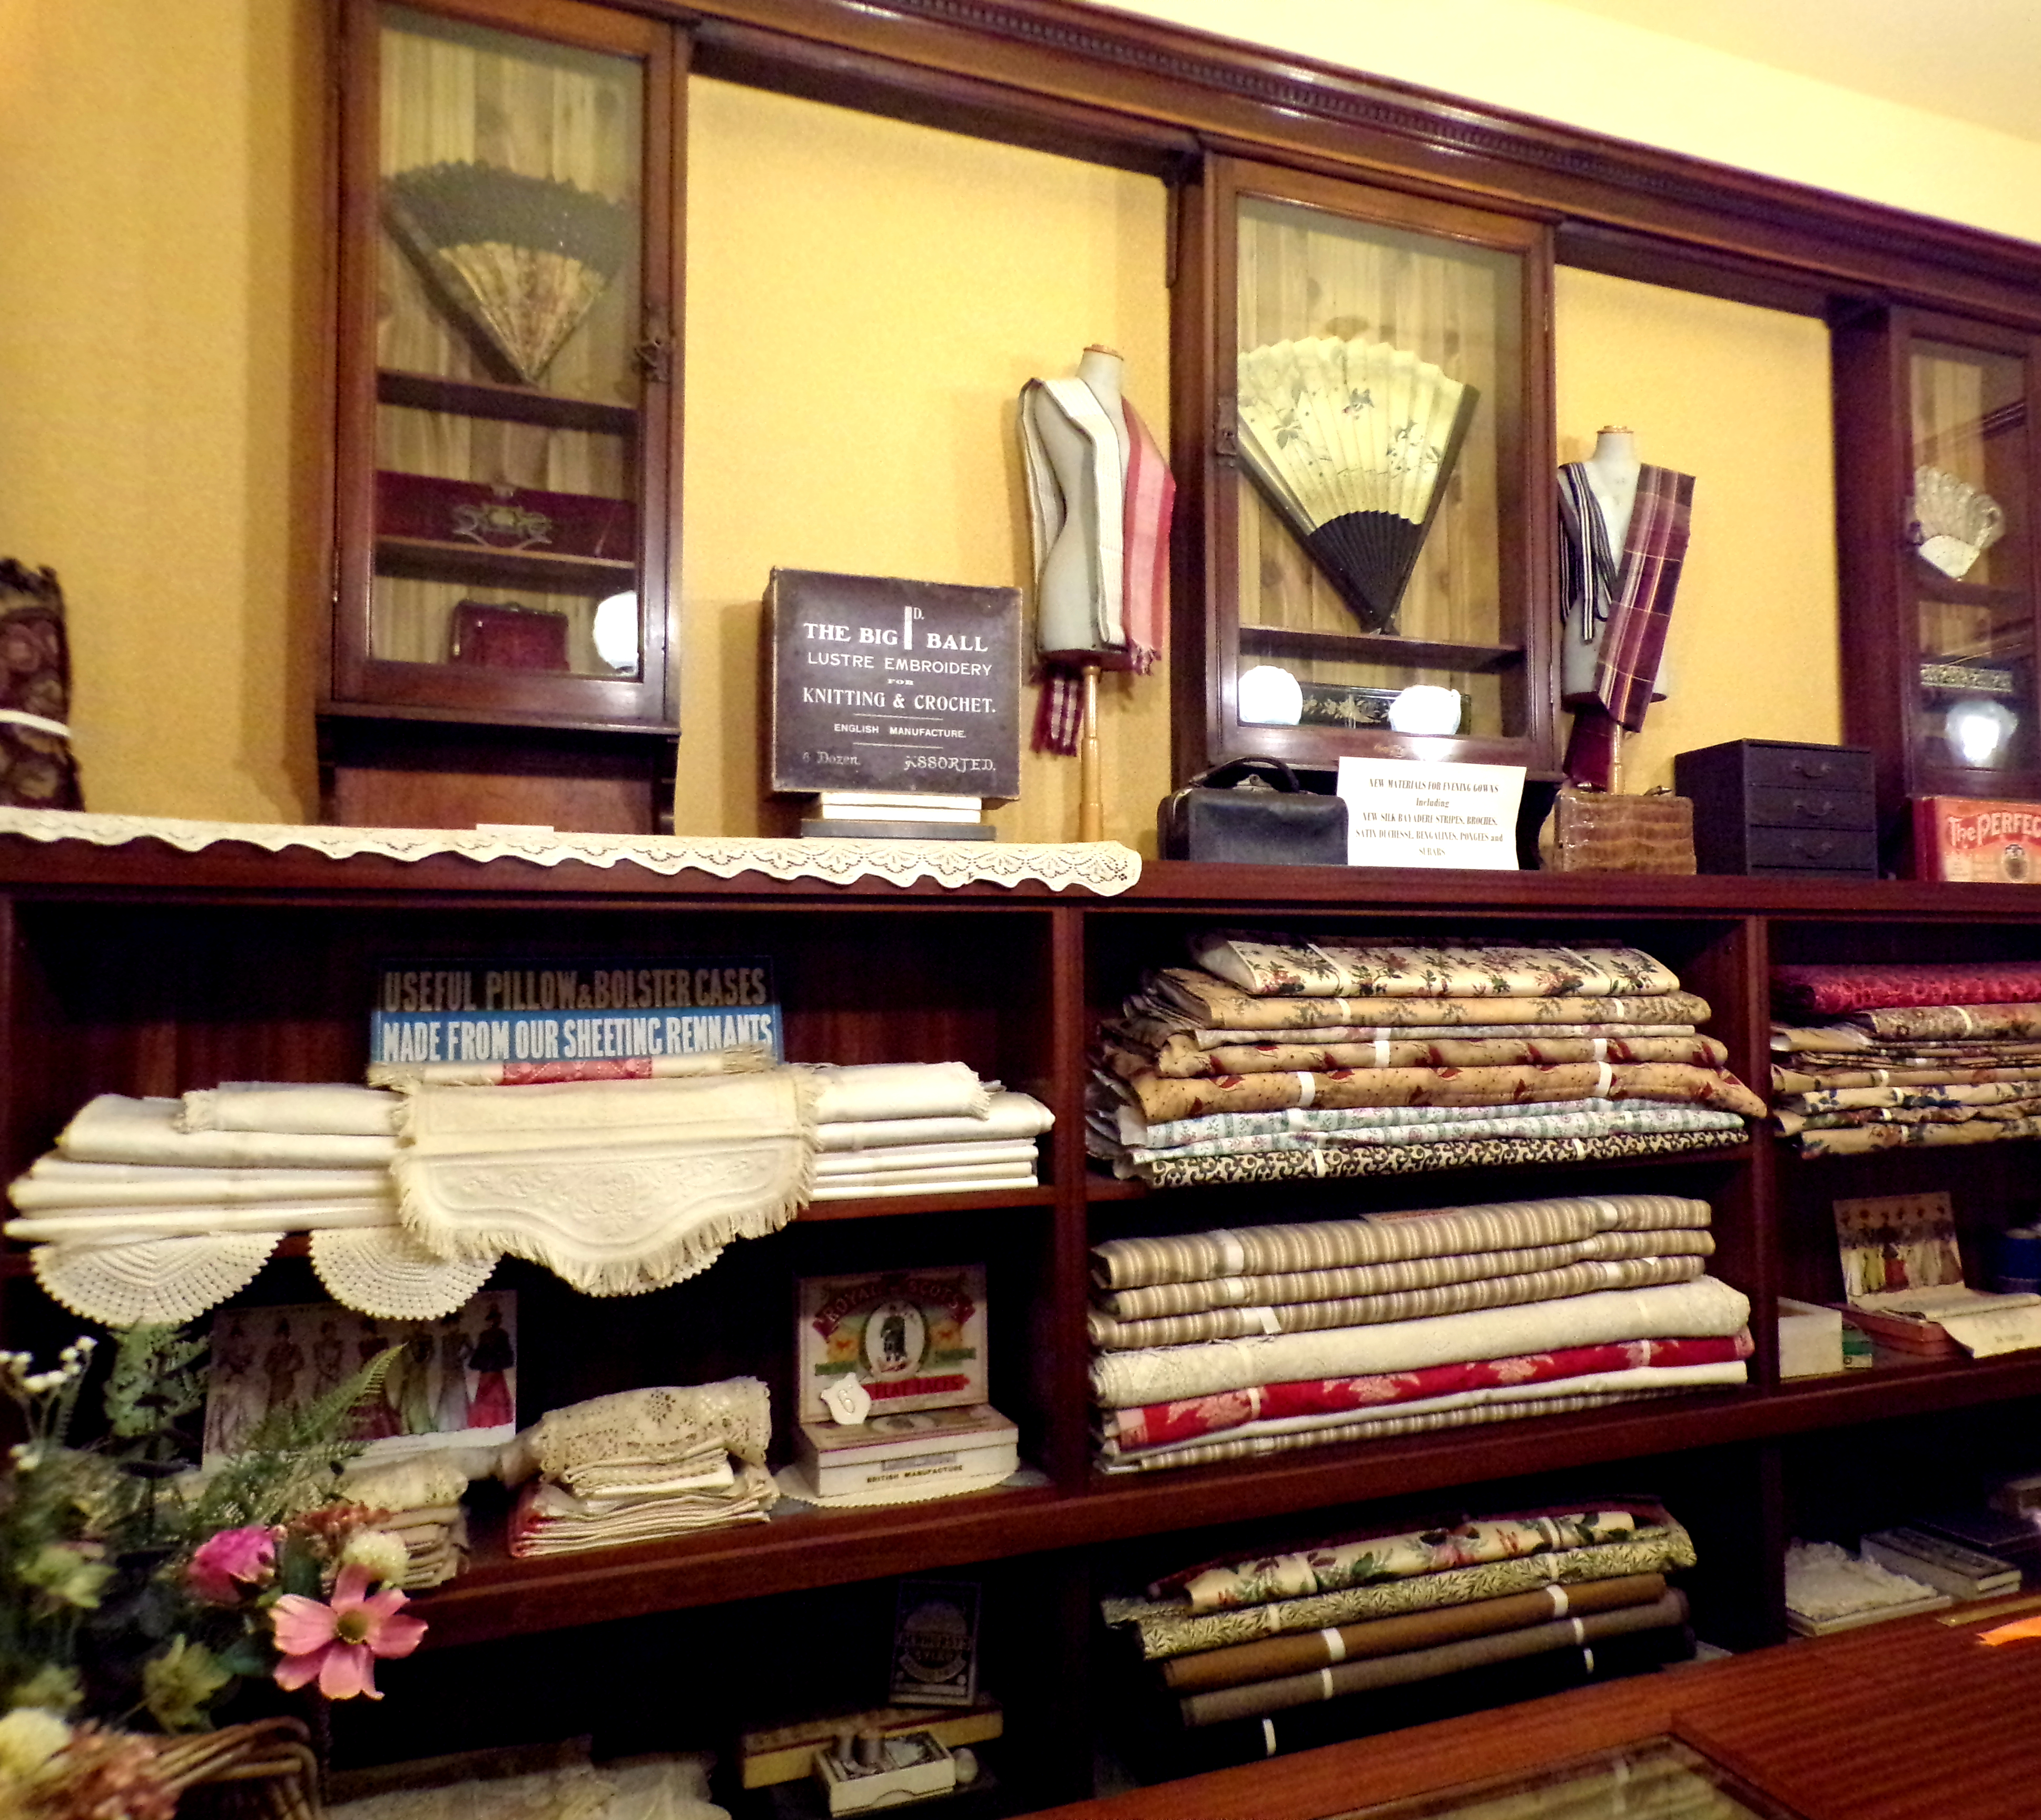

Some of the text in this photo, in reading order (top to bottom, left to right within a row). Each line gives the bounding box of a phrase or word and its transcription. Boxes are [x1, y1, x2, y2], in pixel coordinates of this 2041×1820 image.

[803, 622, 851, 642] THE
[859, 627, 898, 646] BIG
[926, 632, 989, 652] BALL
[807, 651, 992, 676] LUSTRE EMBROIDERY
[803, 687, 997, 713] KNITTING & CROCHET.
[834, 723, 880, 734] ENGLISH
[1369, 778, 1499, 794] NEW MATERIALS FOR EVENING GOWNS
[1416, 797, 1450, 808] Including
[1363, 812, 1377, 821] NEW
[1381, 813, 1396, 822] SILK
[1355, 829, 1377, 838] SATIN
[1490, 834, 1503, 842] and
[1948, 816, 1976, 846] The
[384, 967, 767, 1012] USEFUL PILLOW & BOLSTER CASES
[382, 1014, 773, 1062] MADE FROM OUR SHEETING REMNANTS
